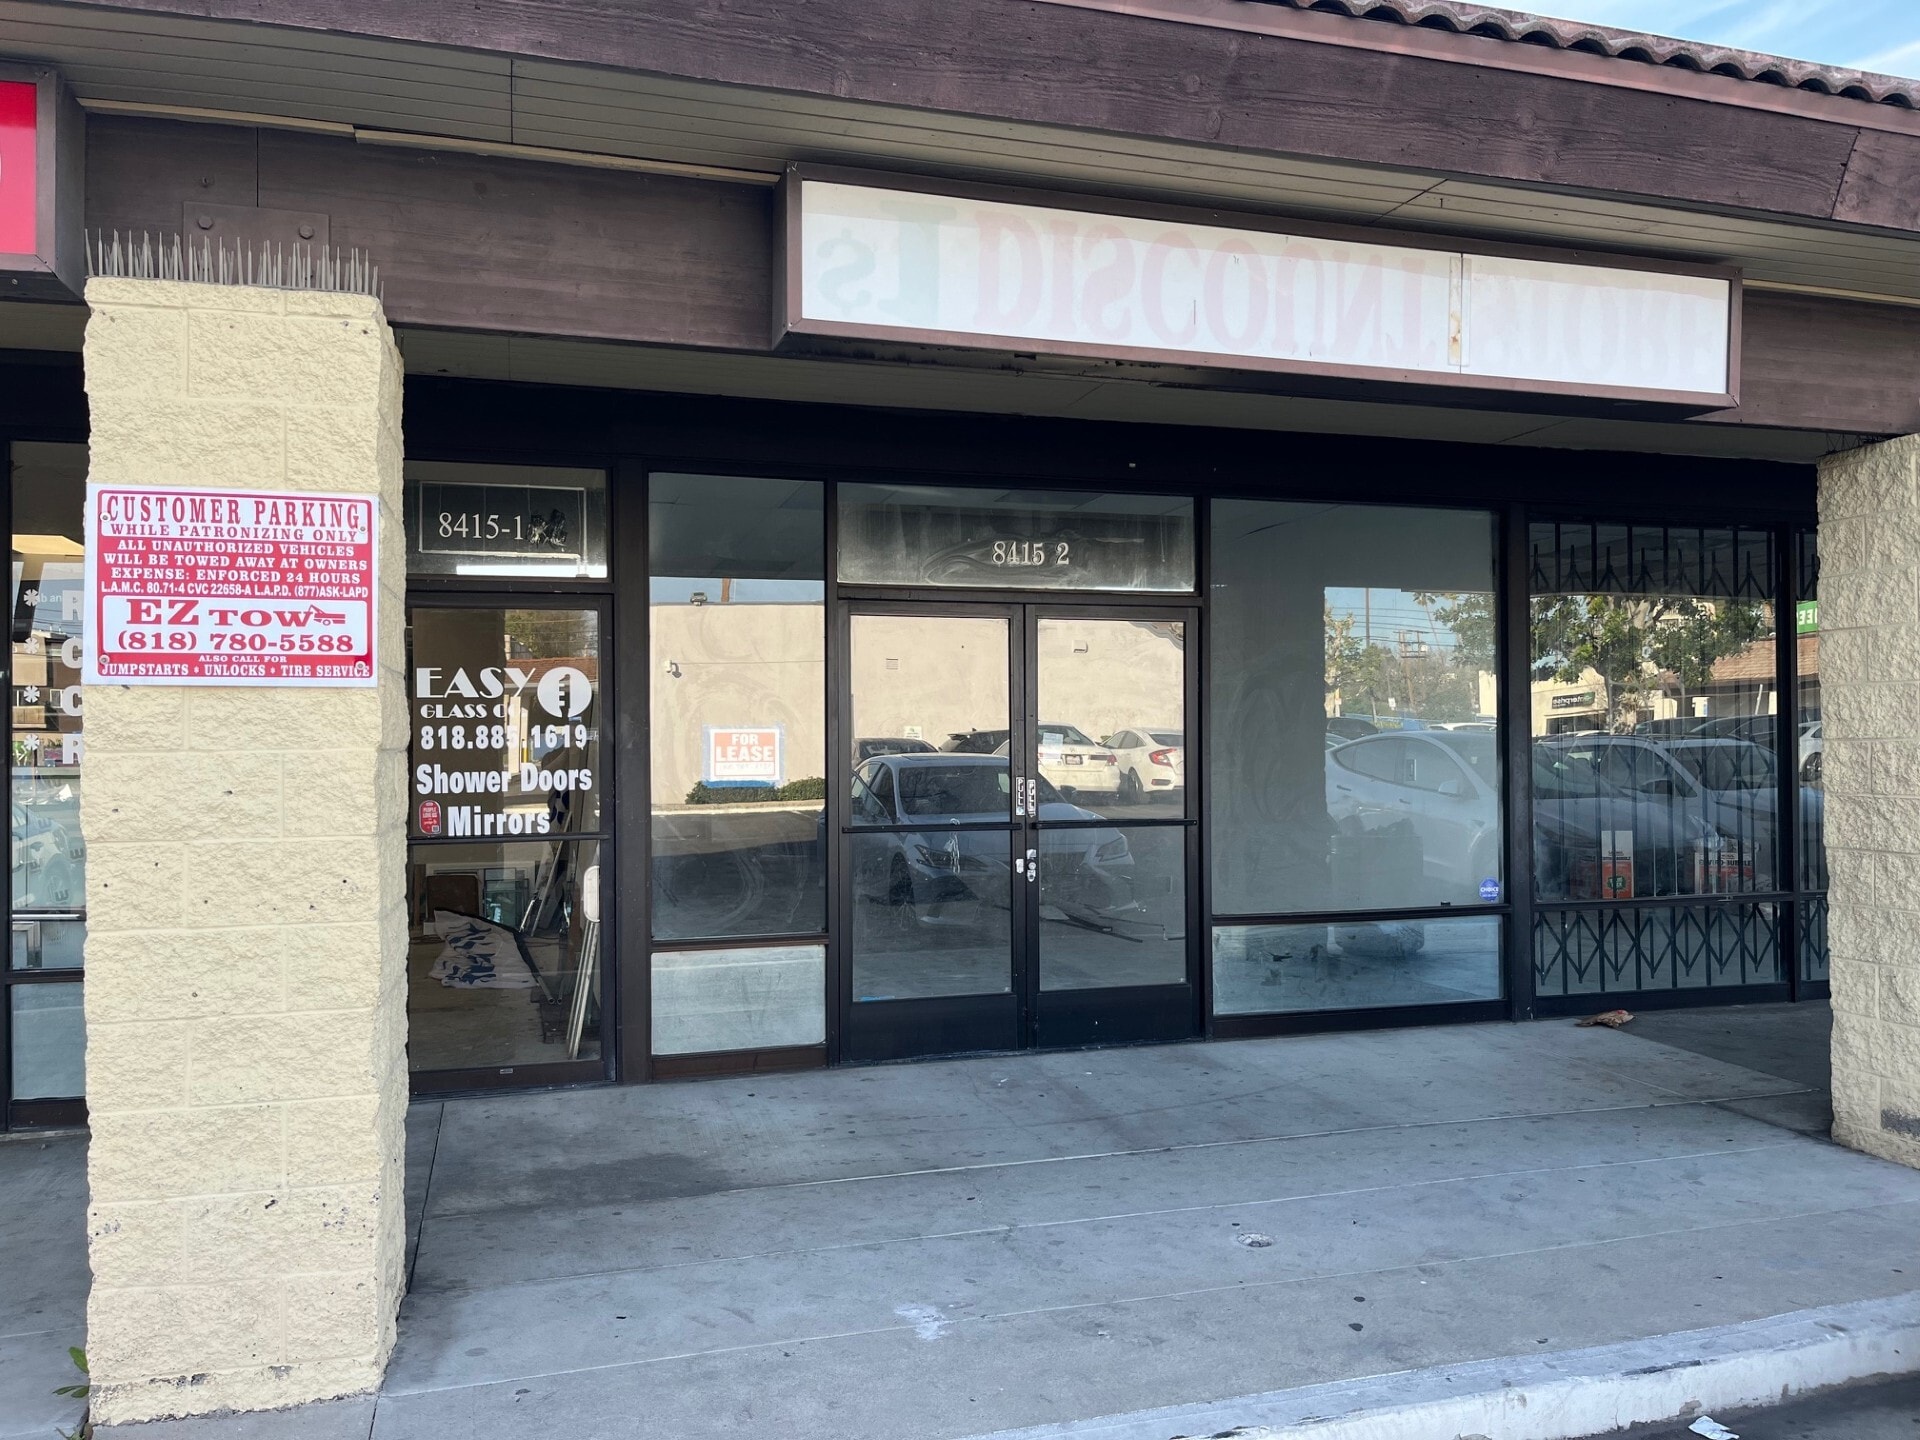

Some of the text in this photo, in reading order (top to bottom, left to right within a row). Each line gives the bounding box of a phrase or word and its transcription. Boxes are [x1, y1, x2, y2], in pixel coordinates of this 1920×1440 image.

[107, 495, 360, 530] CUSTOMER PARKING
[111, 523, 357, 542] WHILE PATRONIZING ONLY
[117, 540, 355, 557] ALL UNAUTHORIZED VEHICLES
[992, 541, 1070, 566] 8415 2
[103, 553, 368, 571] WILL BE TOWED AWAY AT OWNERS
[111, 567, 361, 585] EXPENSE: ENFORCED 24 HOURS
[101, 581, 144, 593] L.A.M.C.
[187, 584, 209, 595] CVC
[210, 584, 252, 597] 22658-A
[254, 585, 292, 597] L.A.P.D.
[126, 599, 313, 628] EZ TOW
[118, 630, 354, 653] (818) 780-5588
[198, 654, 288, 664] ALSO CALL FOR
[101, 663, 370, 678] JUMPSTARTS UNLOCKS TIRE SERVICE
[416, 667, 536, 699] EASY
[420, 704, 488, 719] GLASS
[731, 734, 759, 746] FOR
[715, 746, 774, 762] LEASE
[416, 762, 593, 795] Shower Doors
[447, 806, 550, 837] Mirrors
